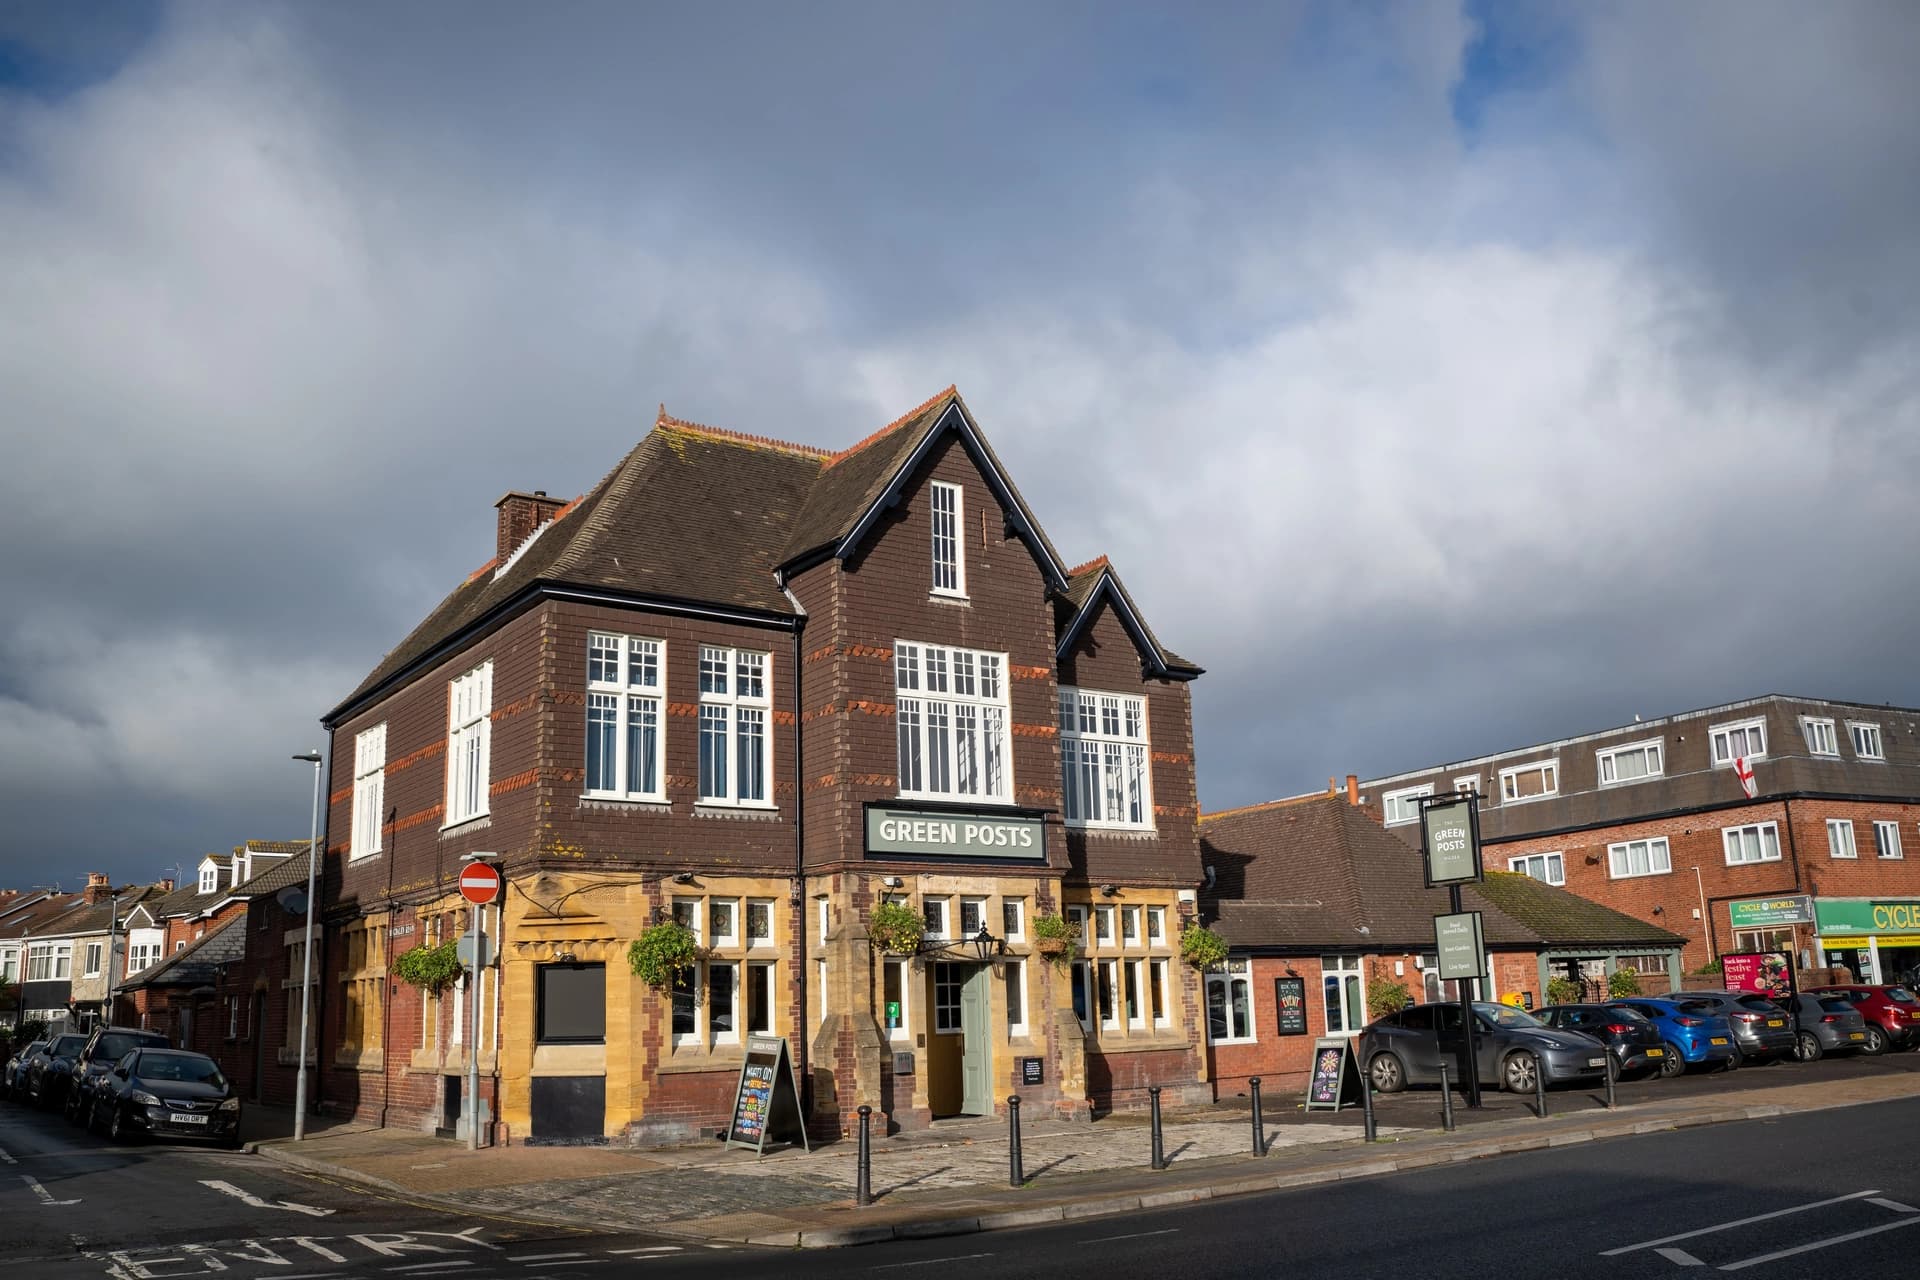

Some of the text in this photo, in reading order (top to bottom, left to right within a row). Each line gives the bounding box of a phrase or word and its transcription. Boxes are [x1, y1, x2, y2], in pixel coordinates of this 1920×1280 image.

[879, 820, 1033, 848] GREEN POSTS
[1435, 828, 1465, 841] GREEN
[1437, 840, 1465, 852] POSTS
[1738, 903, 1760, 912] CYCLE
[1769, 901, 1795, 910] WORLD
[1873, 905, 1920, 929] CYCLE
[1725, 964, 1751, 972] festive
[1726, 973, 1745, 981] feast
[1281, 995, 1301, 1008] EVENT
